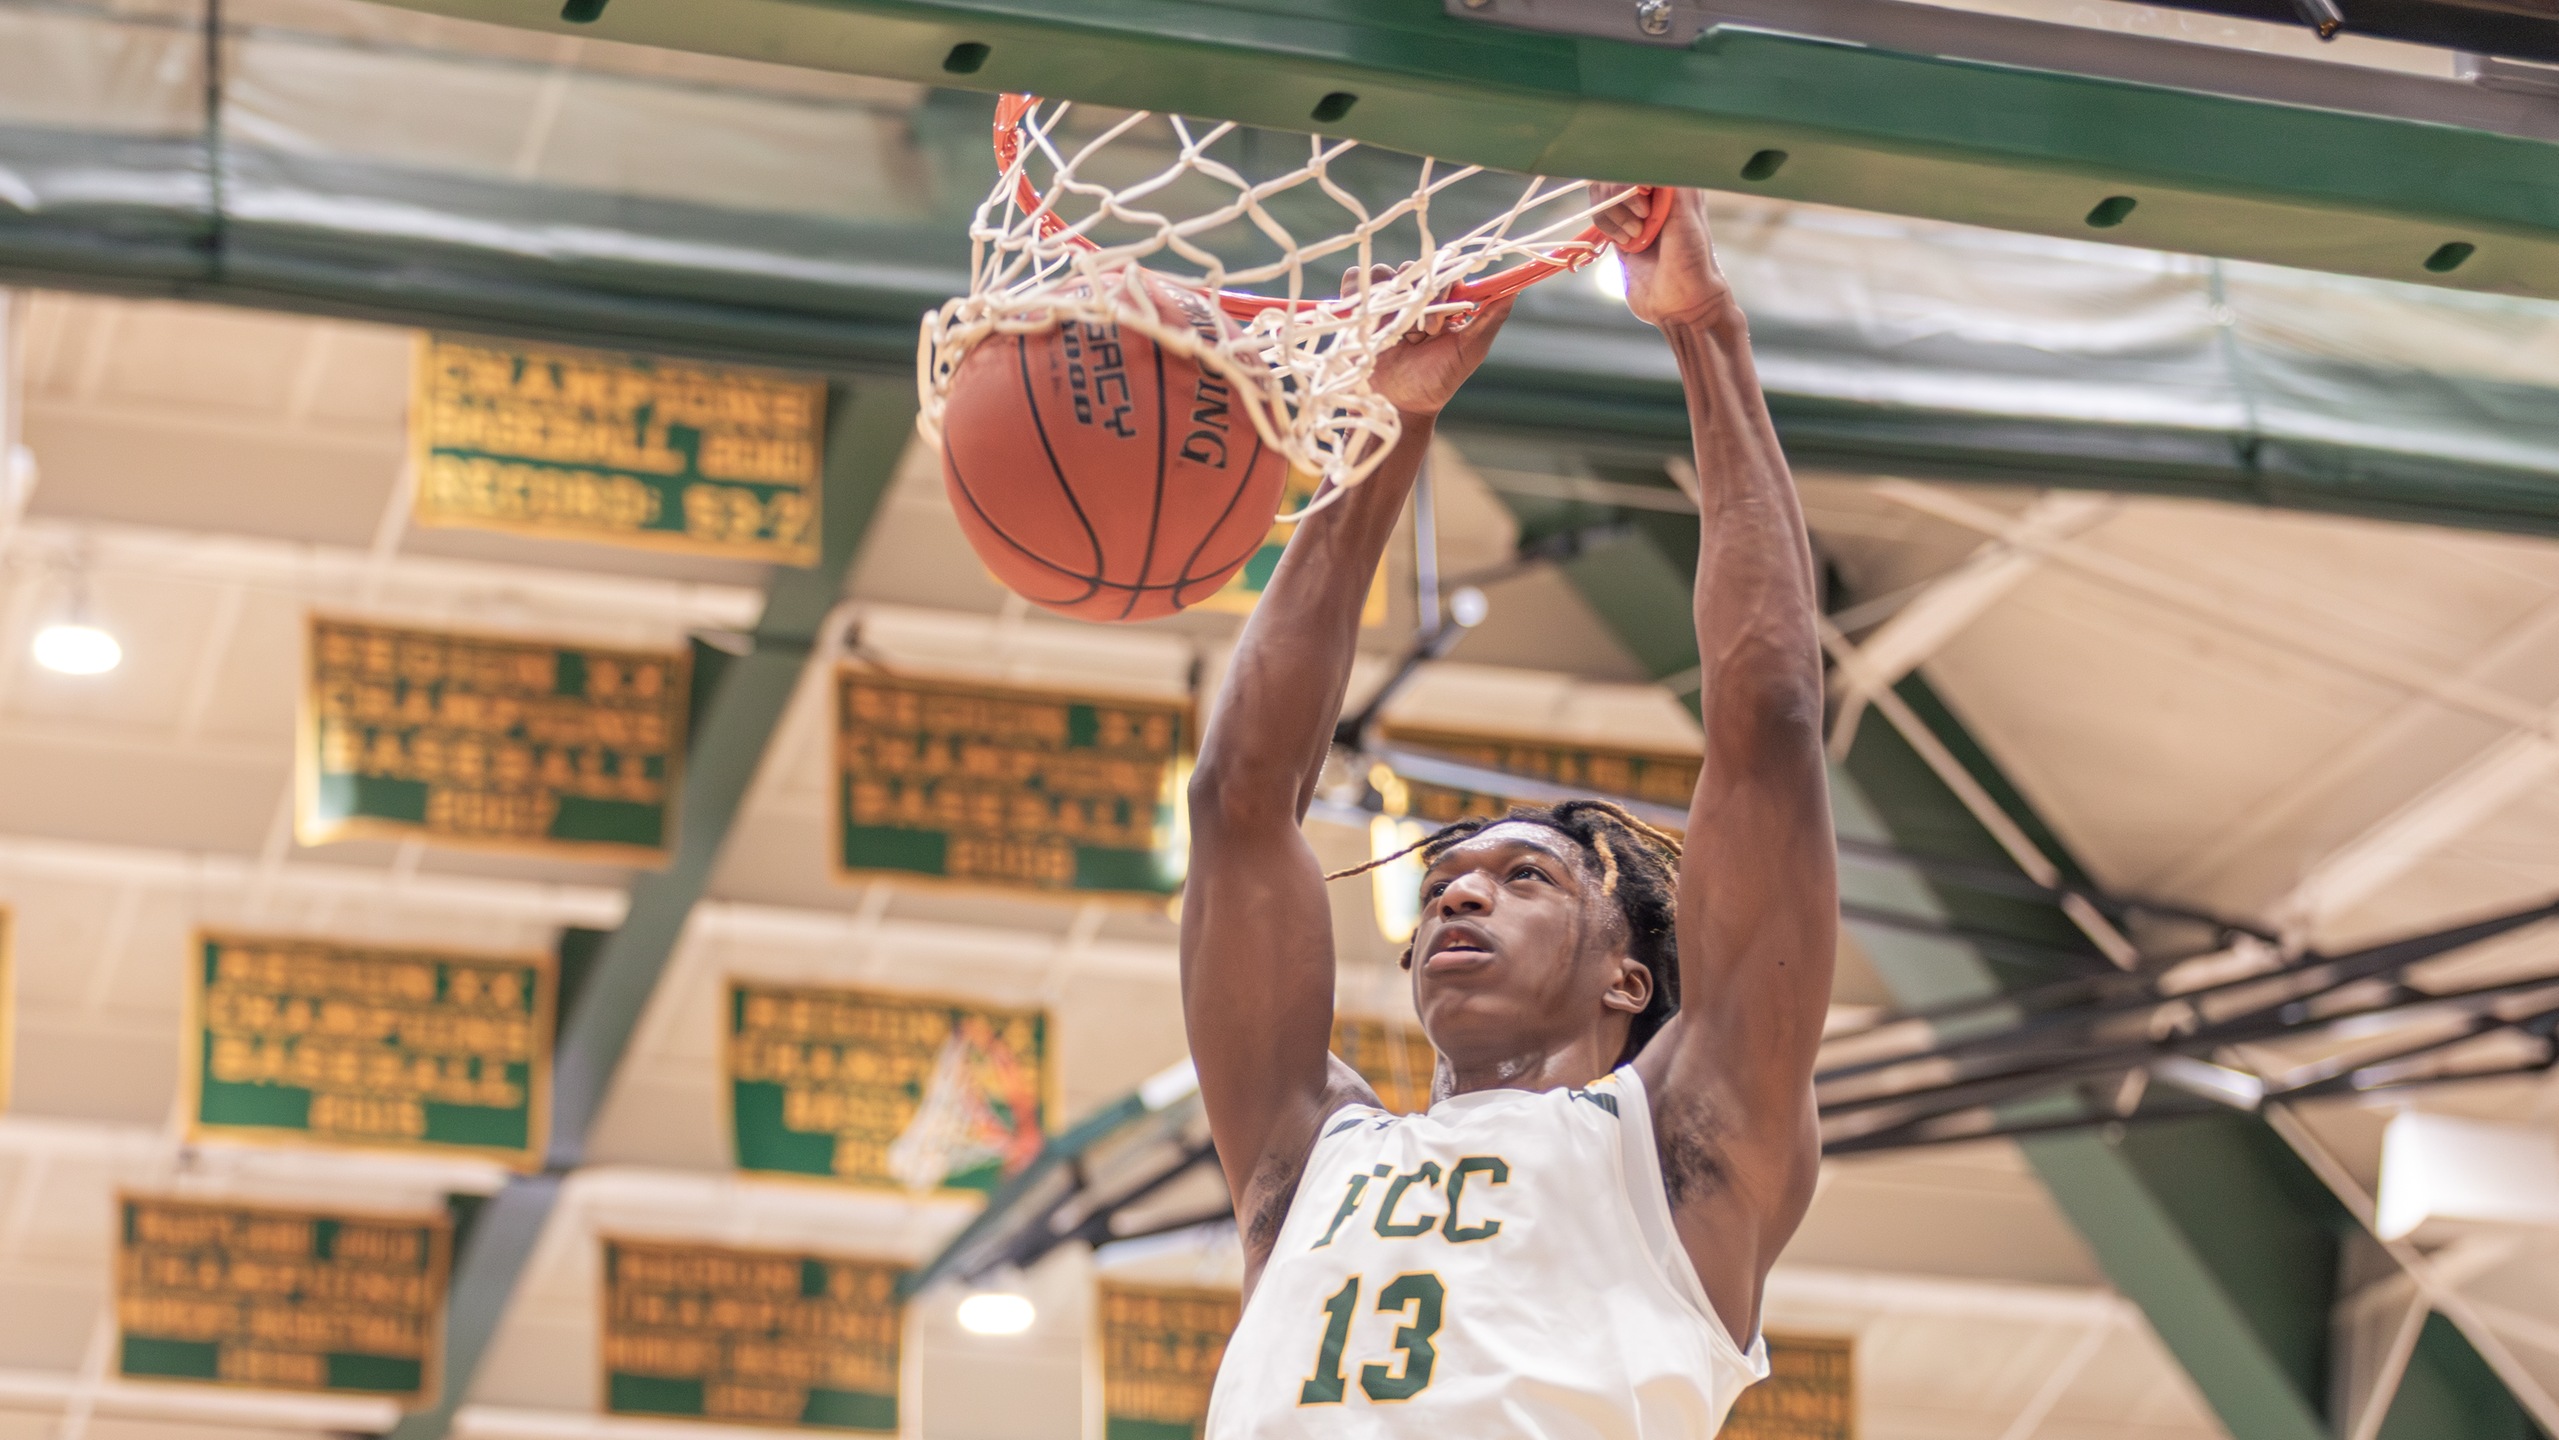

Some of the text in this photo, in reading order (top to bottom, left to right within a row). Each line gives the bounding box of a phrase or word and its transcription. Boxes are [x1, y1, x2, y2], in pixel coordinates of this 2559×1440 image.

[1085, 321, 1137, 438] GACY
[1309, 1154, 1512, 1250] FCC
[1297, 1271, 1448, 1407] 13
